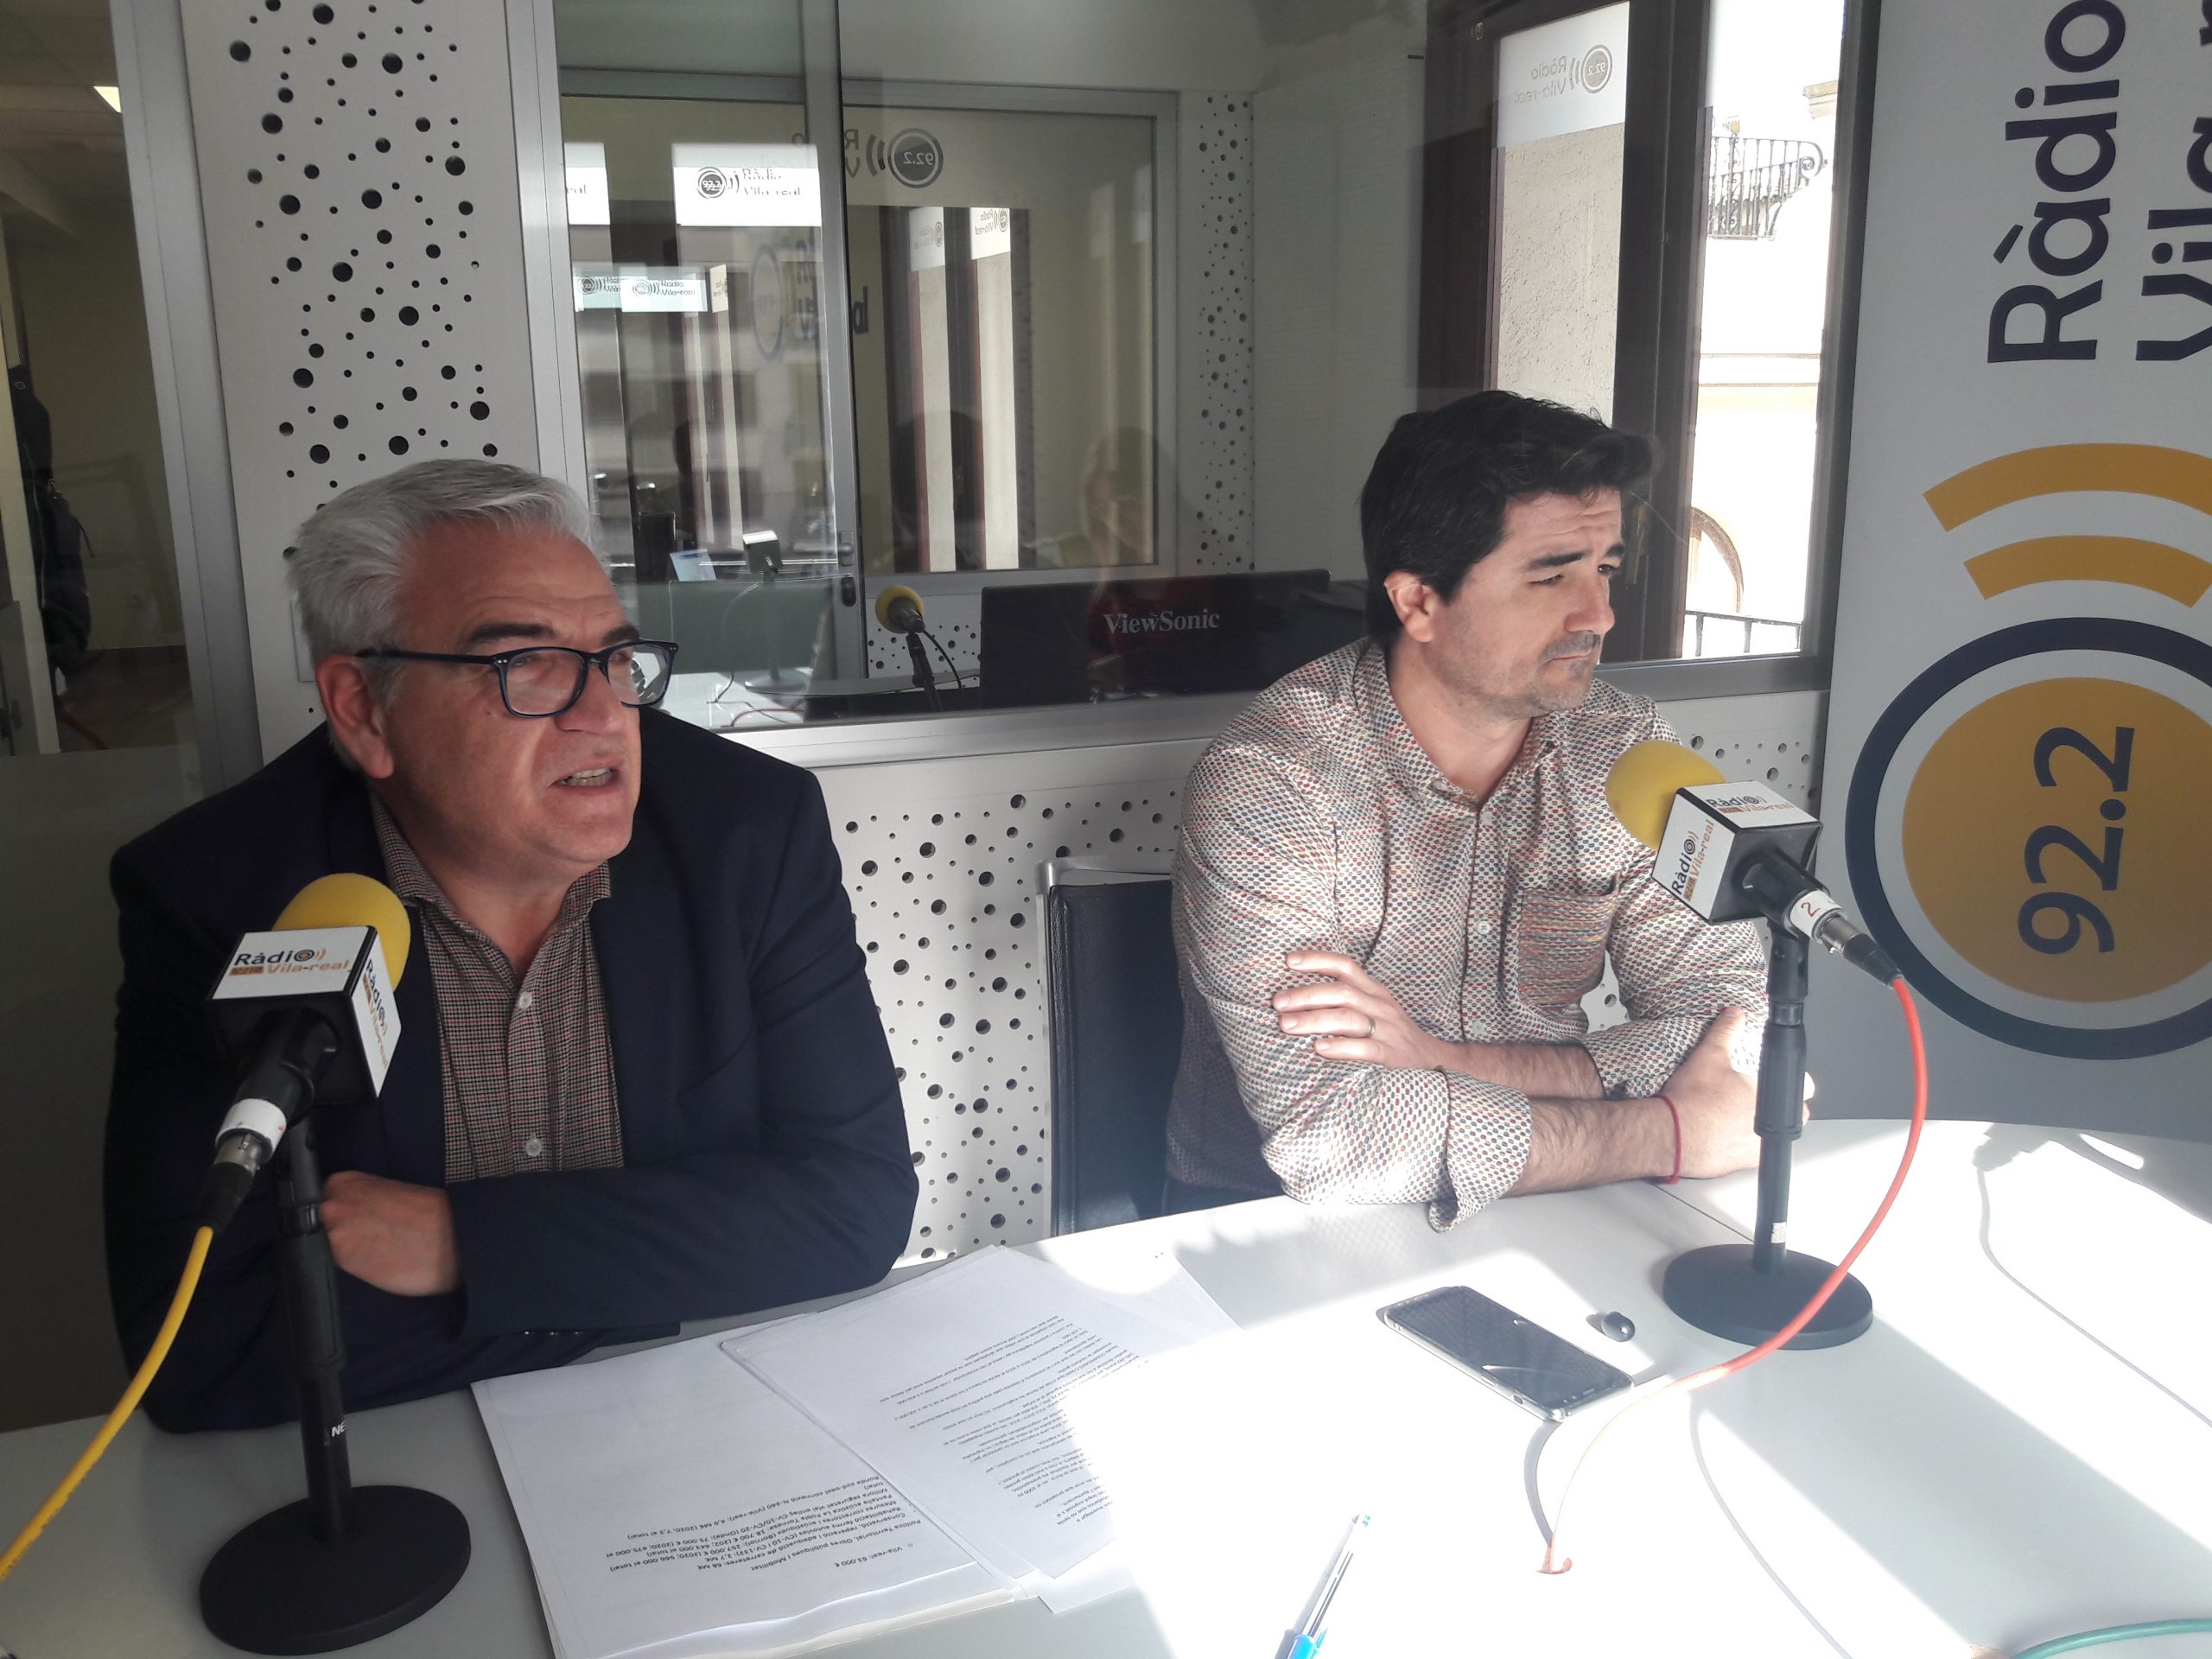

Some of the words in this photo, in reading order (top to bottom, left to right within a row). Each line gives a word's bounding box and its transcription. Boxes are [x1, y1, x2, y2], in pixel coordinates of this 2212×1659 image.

[1987, 0, 2126, 363] Ràdio
[1103, 608, 1220, 634] ViewSonic
[2018, 726, 2135, 954] 92.2
